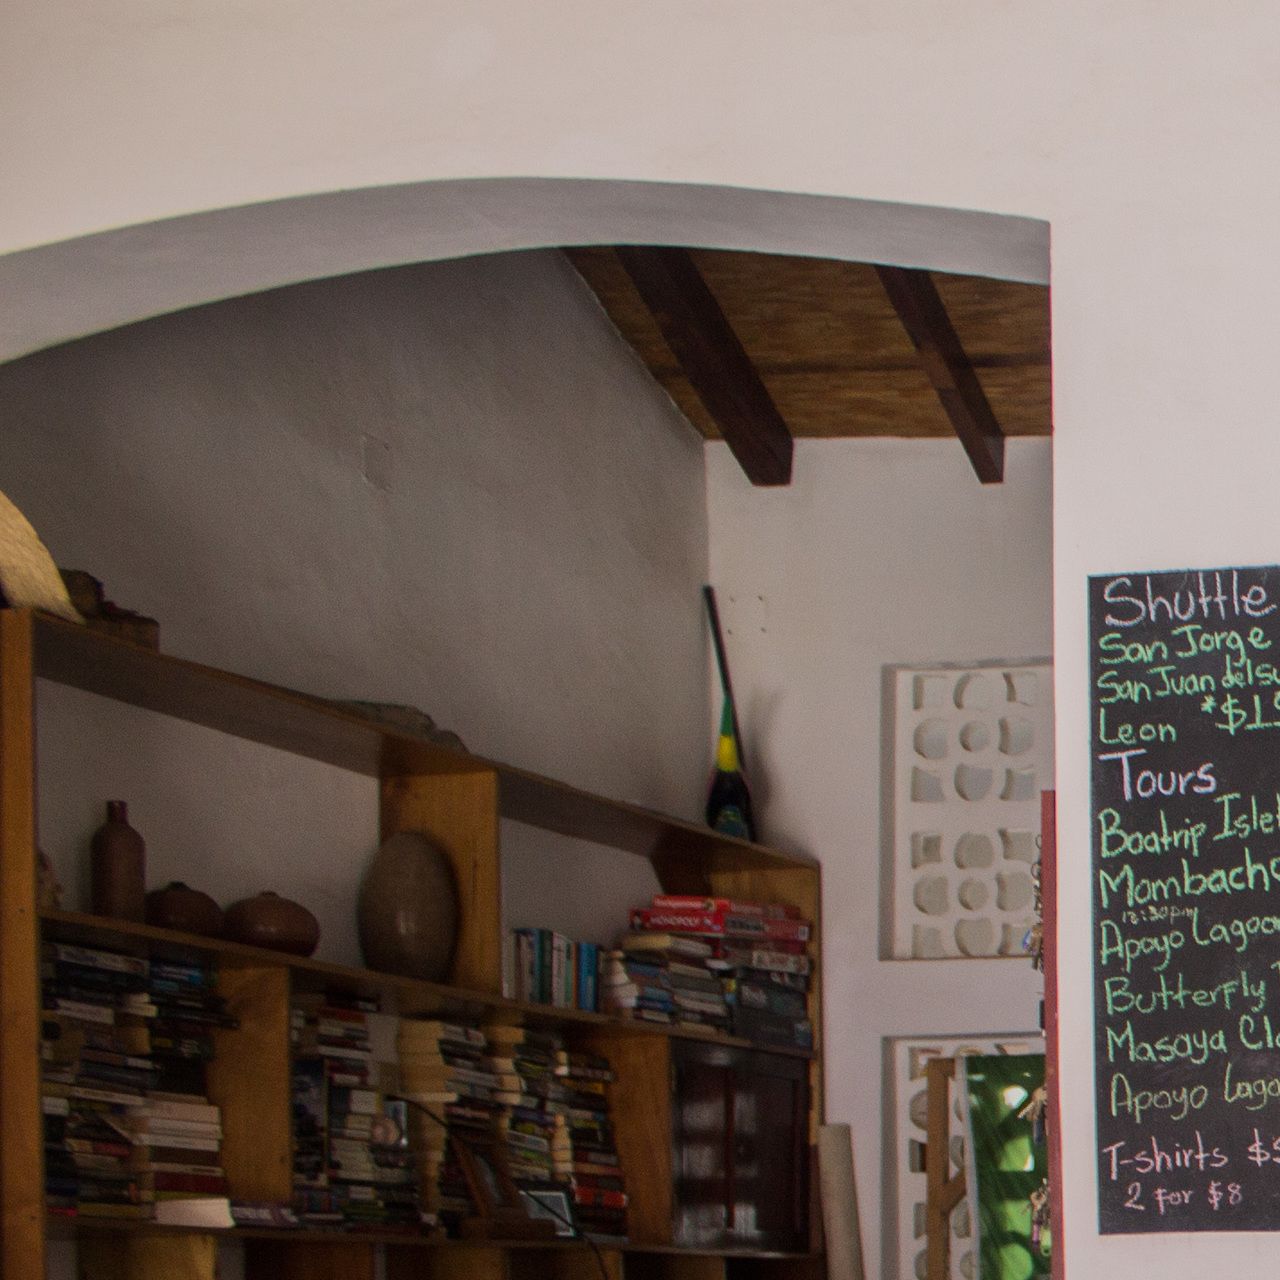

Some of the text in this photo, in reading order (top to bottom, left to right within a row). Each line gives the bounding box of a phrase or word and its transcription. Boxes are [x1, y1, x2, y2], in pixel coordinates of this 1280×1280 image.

[1104, 570, 1277, 627] Shuttle
[1099, 625, 1273, 667] San Jorge
[1097, 671, 1151, 704] San
[1147, 665, 1216, 698] Juan
[1100, 707, 1177, 745] Leon
[1099, 748, 1217, 801] Tours
[1100, 919, 1185, 974] Apoyo
[1106, 1020, 1228, 1064] Masaya
[1110, 1072, 1208, 1124] Apoyo
[1103, 1130, 1229, 1181] T-shirts
[1124, 1182, 1146, 1211] 2
[1207, 1180, 1243, 1210] $8
